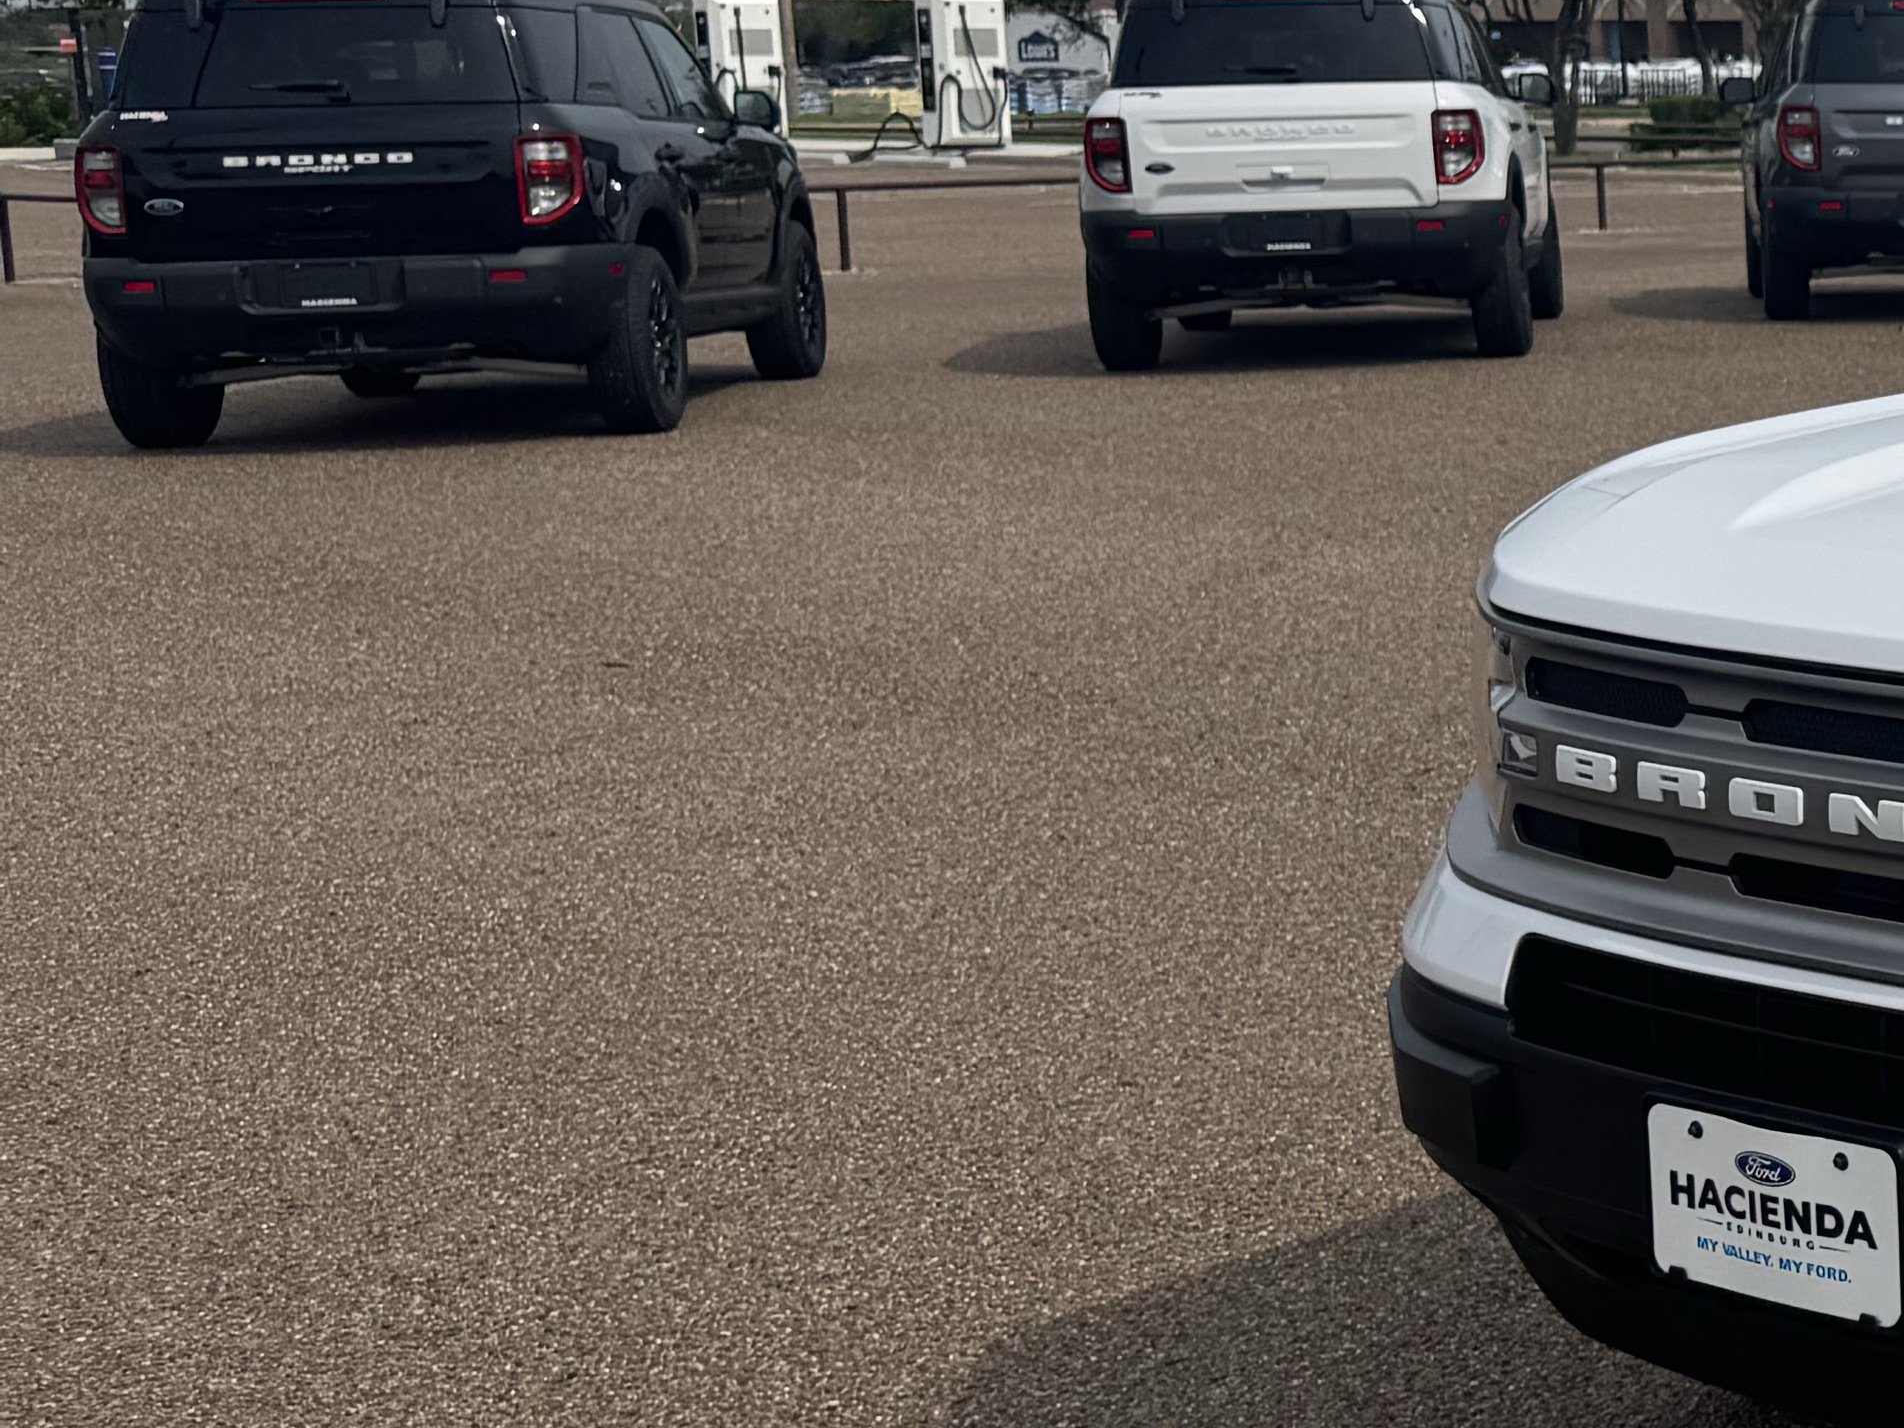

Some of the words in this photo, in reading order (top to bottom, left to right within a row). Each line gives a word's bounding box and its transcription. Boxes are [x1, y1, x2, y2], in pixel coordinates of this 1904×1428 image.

[222, 152, 414, 168] BRONCO
[1745, 1154, 1782, 1182] Ford
[1669, 1169, 1879, 1251] HACIENDA
[1726, 1222, 1815, 1251] EDINBURG
[1696, 1235, 1719, 1253] MY
[1722, 1243, 1774, 1268] VALLEY.
[1779, 1256, 1803, 1274] MY
[1807, 1263, 1852, 1284] FORD.
